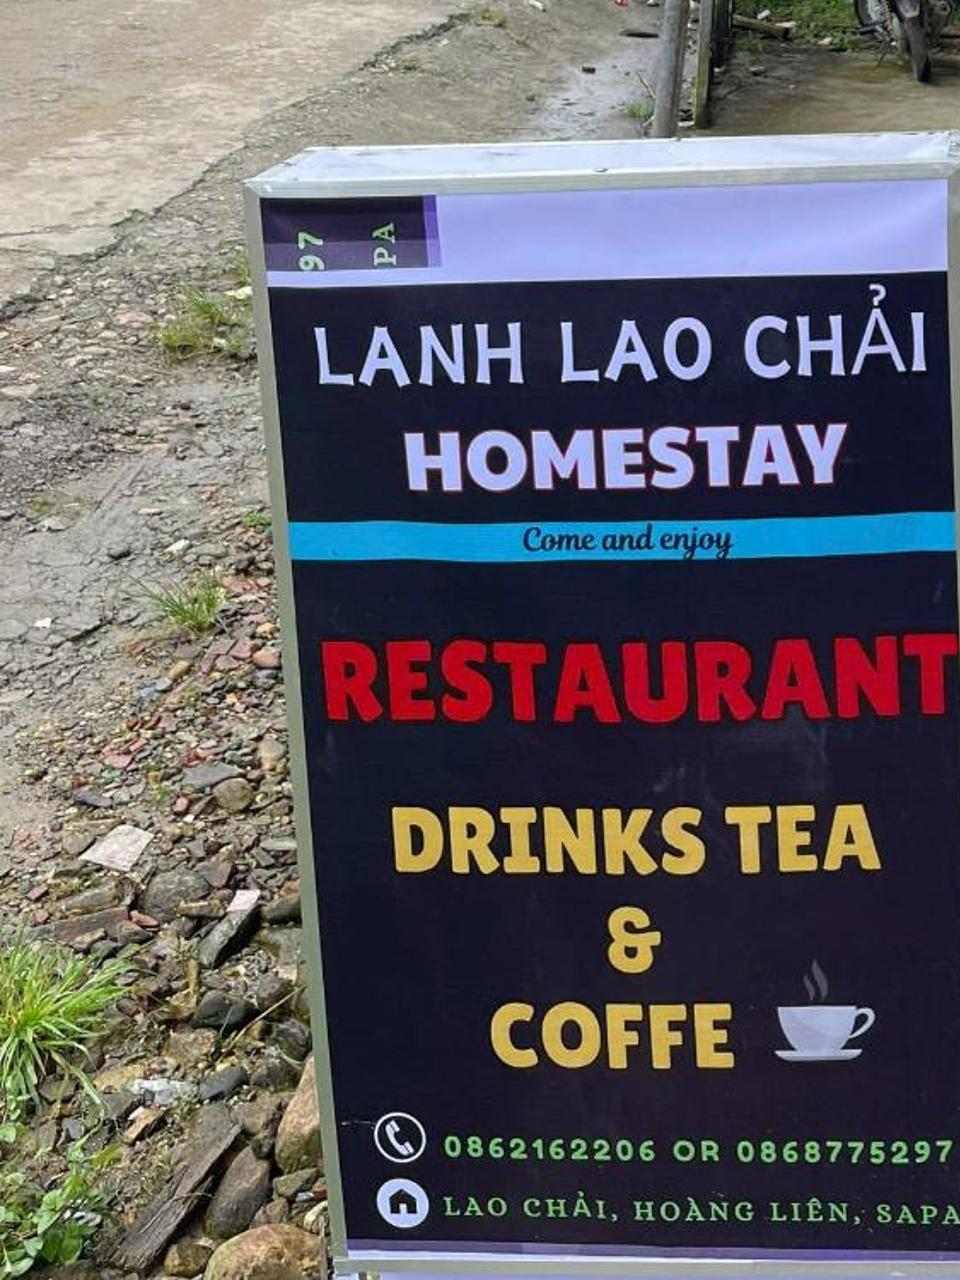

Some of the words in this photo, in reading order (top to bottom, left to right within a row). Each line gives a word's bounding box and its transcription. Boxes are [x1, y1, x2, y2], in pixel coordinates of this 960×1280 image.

[298, 231, 326, 272] 97
[371, 221, 397, 266] PA
[313, 321, 524, 388] LANH
[560, 317, 713, 383] LAO
[743, 284, 928, 378] CHẢI
[403, 422, 848, 494] HOMESTAY
[522, 526, 597, 553] Come
[601, 523, 656, 552] and
[660, 526, 735, 561] enjoy
[320, 632, 959, 723] RESTAURANT
[391, 805, 707, 877] DRINKS
[724, 803, 883, 875] TEA
[606, 904, 663, 975] &
[489, 1000, 736, 1070] COFFE
[443, 1135, 657, 1163] 0862162206
[672, 1139, 720, 1163] OR
[736, 1139, 954, 1164] 0868775297
[442, 1196, 508, 1217] LAO
[522, 1189, 619, 1222] CHẢI,
[632, 1196, 756, 1222] HOÀNG
